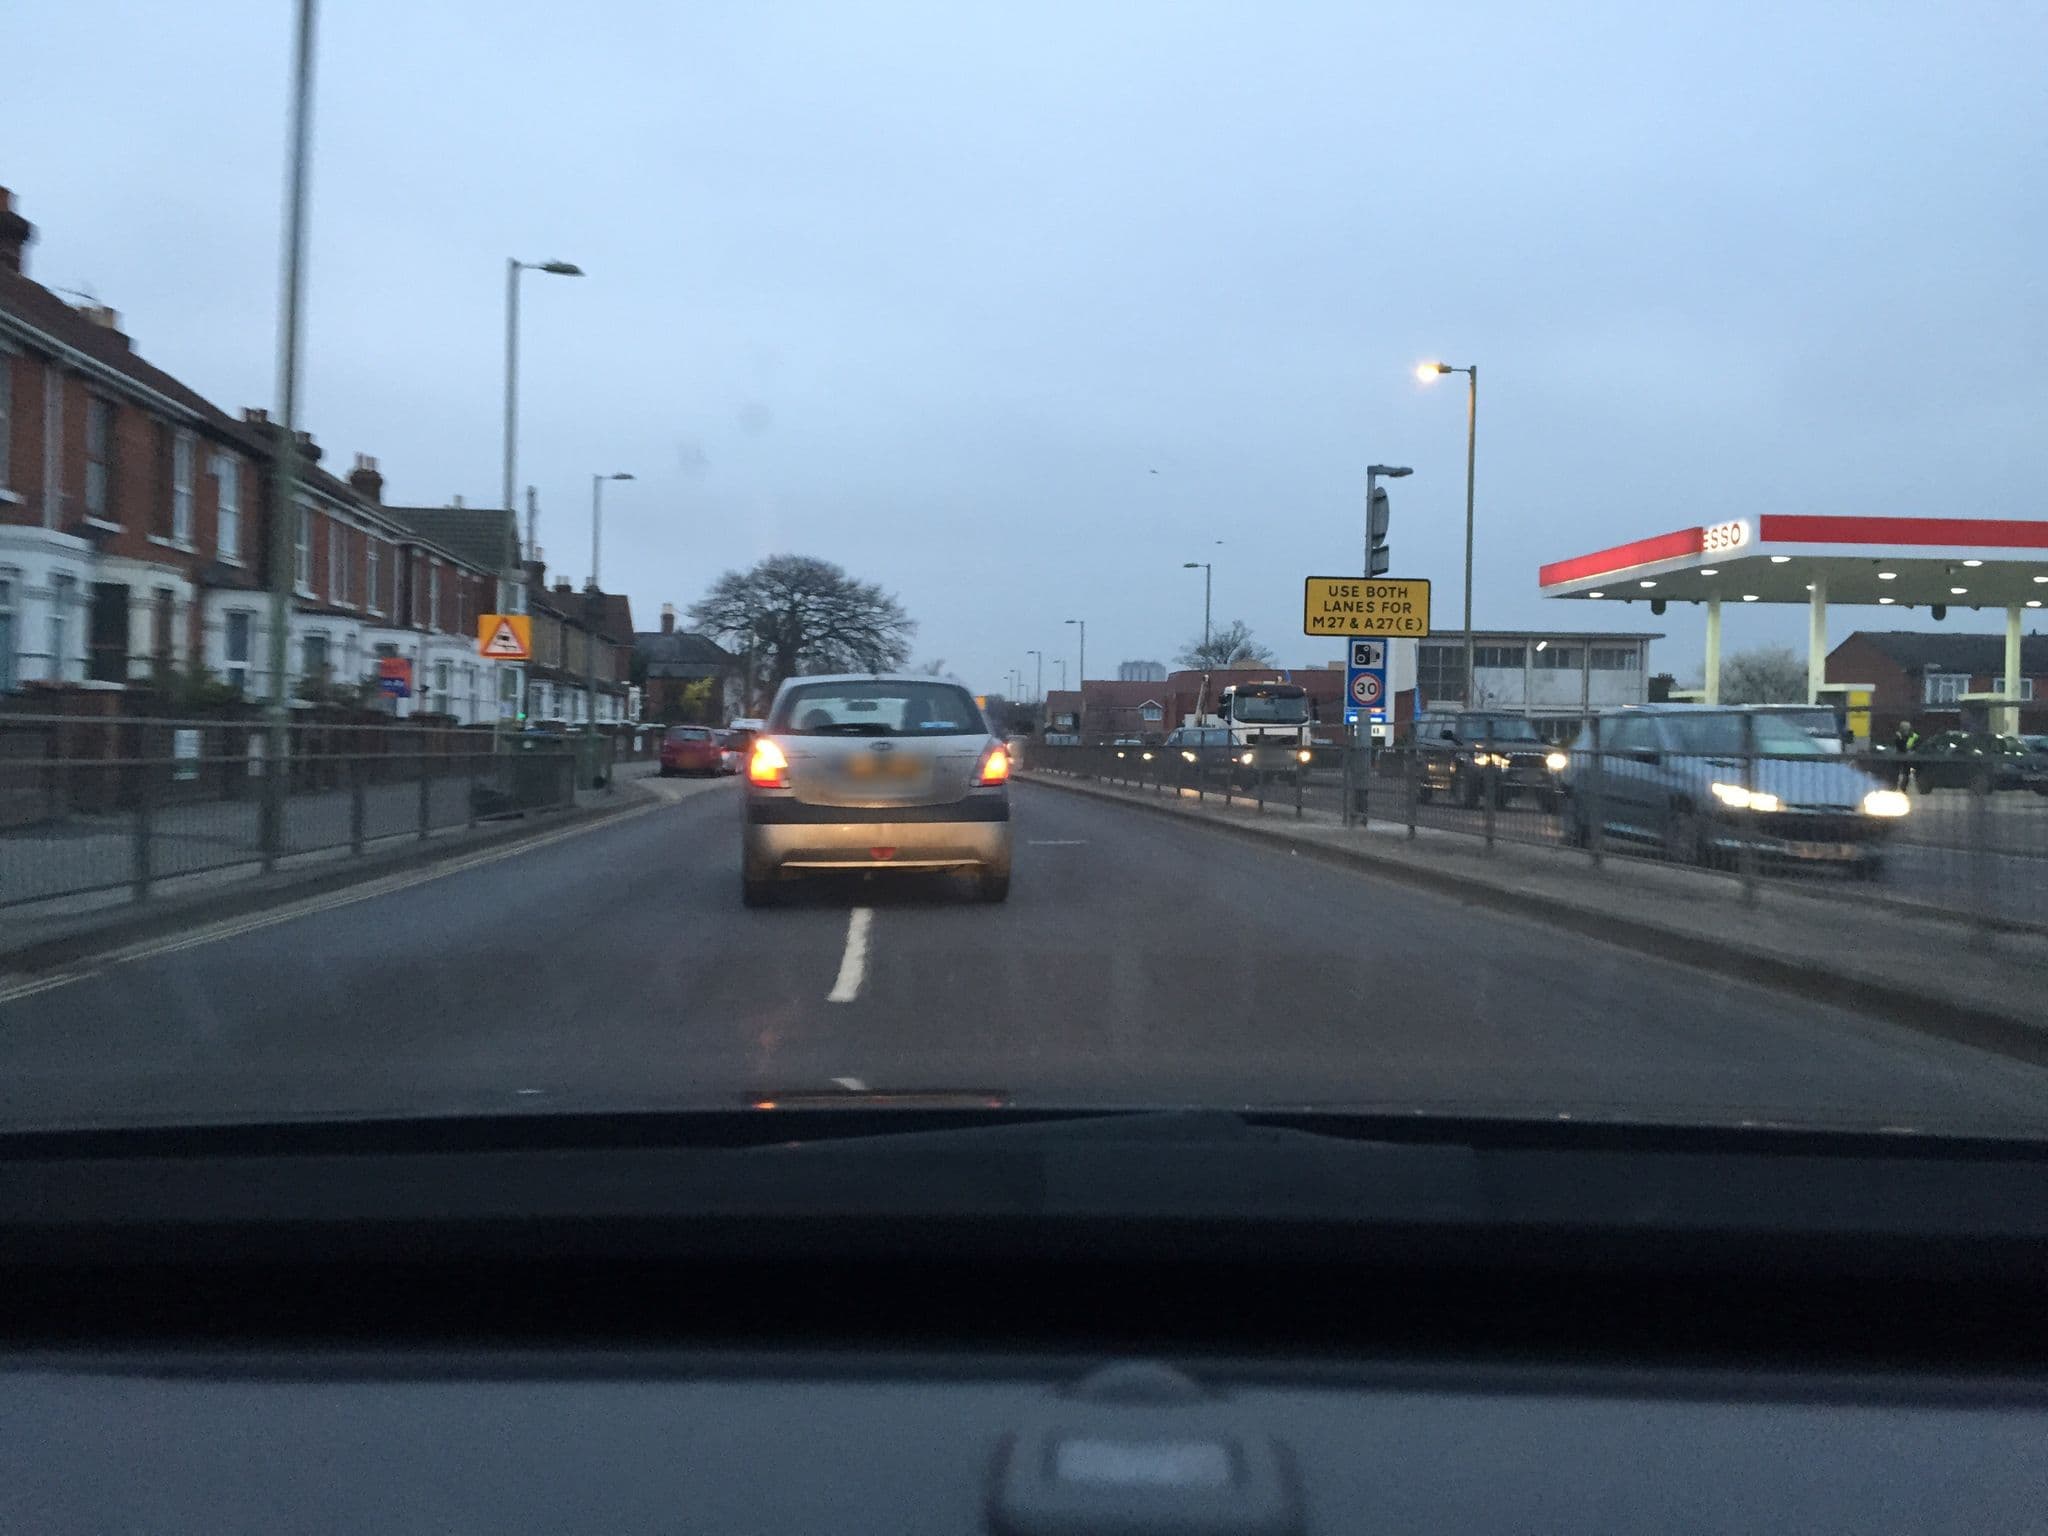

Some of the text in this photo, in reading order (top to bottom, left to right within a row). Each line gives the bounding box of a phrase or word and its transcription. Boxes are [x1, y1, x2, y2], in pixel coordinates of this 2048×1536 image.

[1703, 523, 1741, 550] ESSO
[1328, 585, 1408, 599] USE BOTH
[1324, 601, 1412, 614] LANES FOR
[1312, 616, 1423, 632] M27 & A27(E)
[1356, 682, 1377, 696] 30
